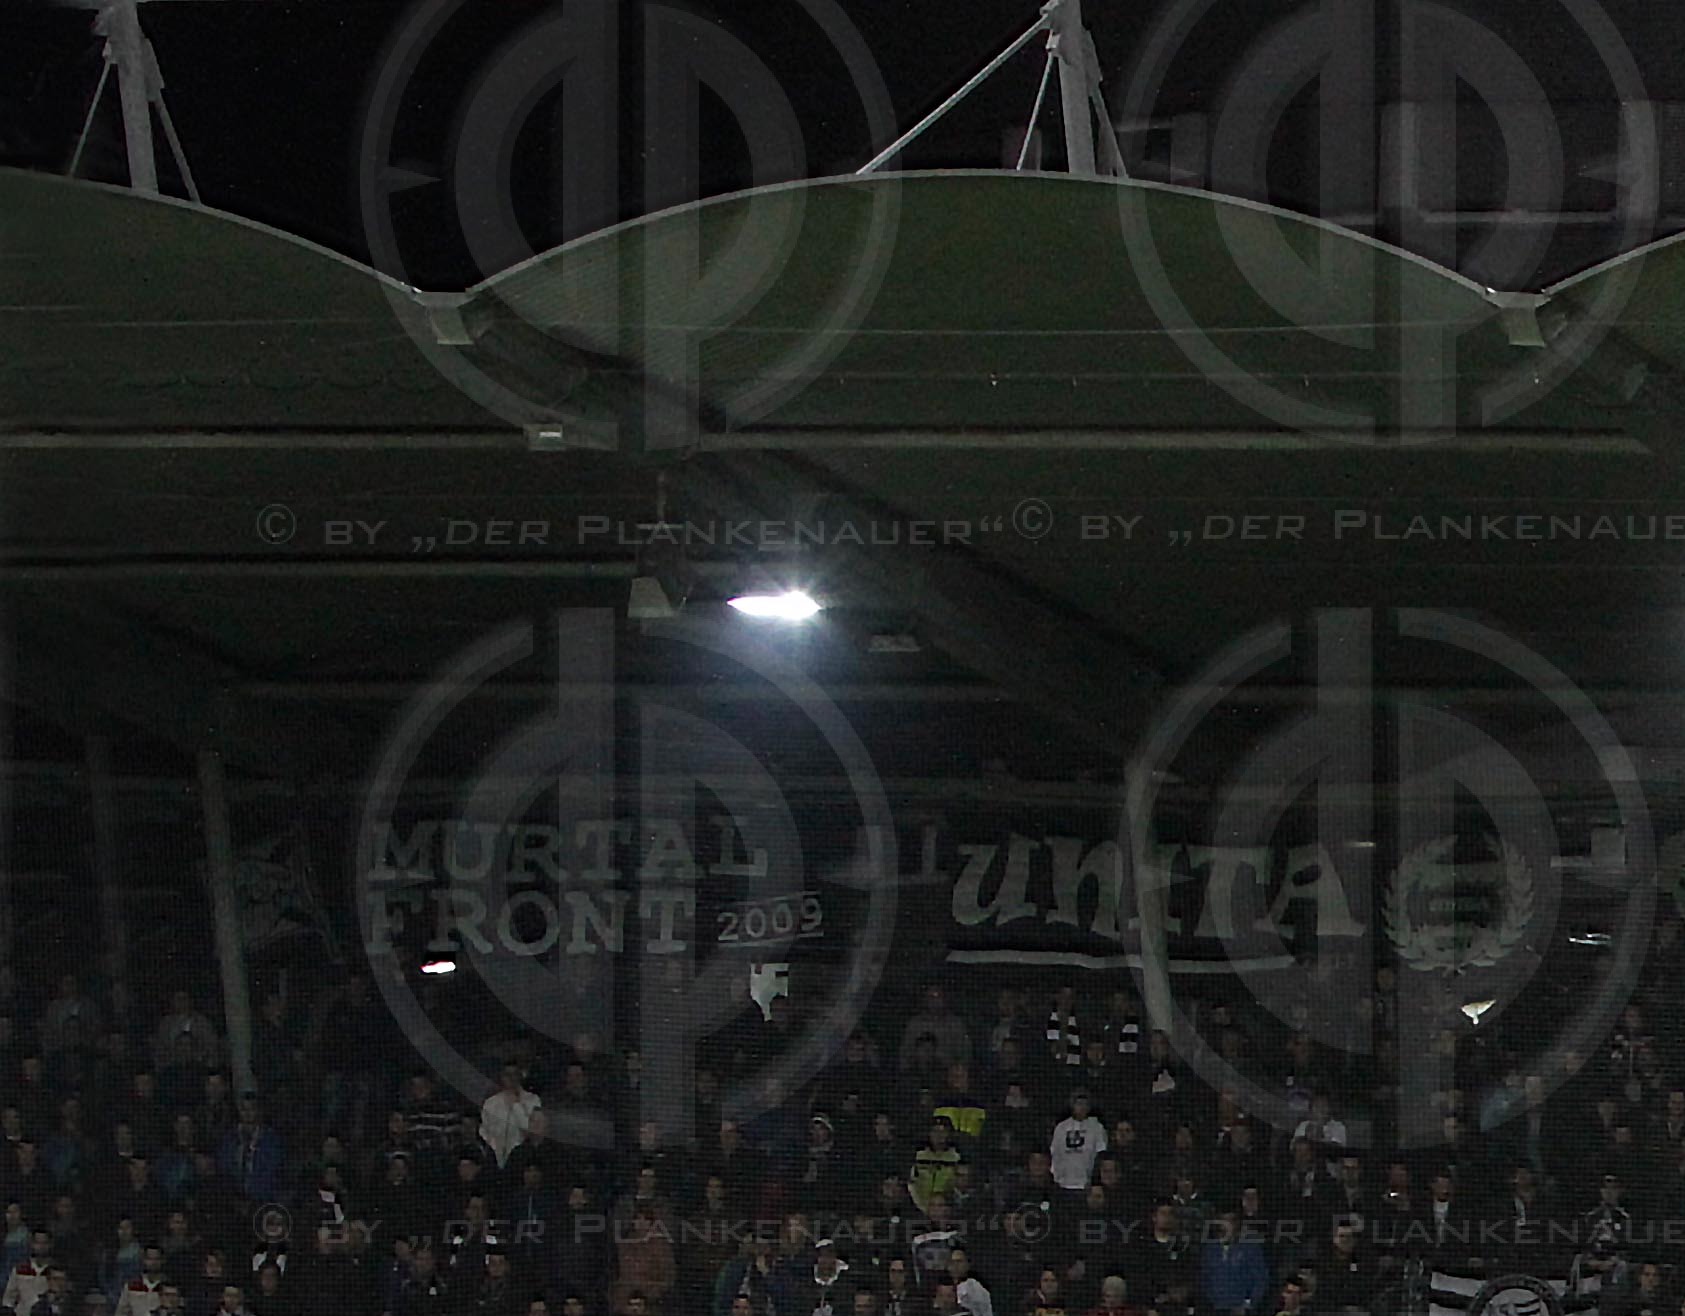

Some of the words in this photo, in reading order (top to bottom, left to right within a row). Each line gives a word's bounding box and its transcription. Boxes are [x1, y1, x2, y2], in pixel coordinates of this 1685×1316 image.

[368, 818, 768, 882] MURTAL
[366, 889, 698, 956] FRONT
[717, 895, 824, 941] 2009
